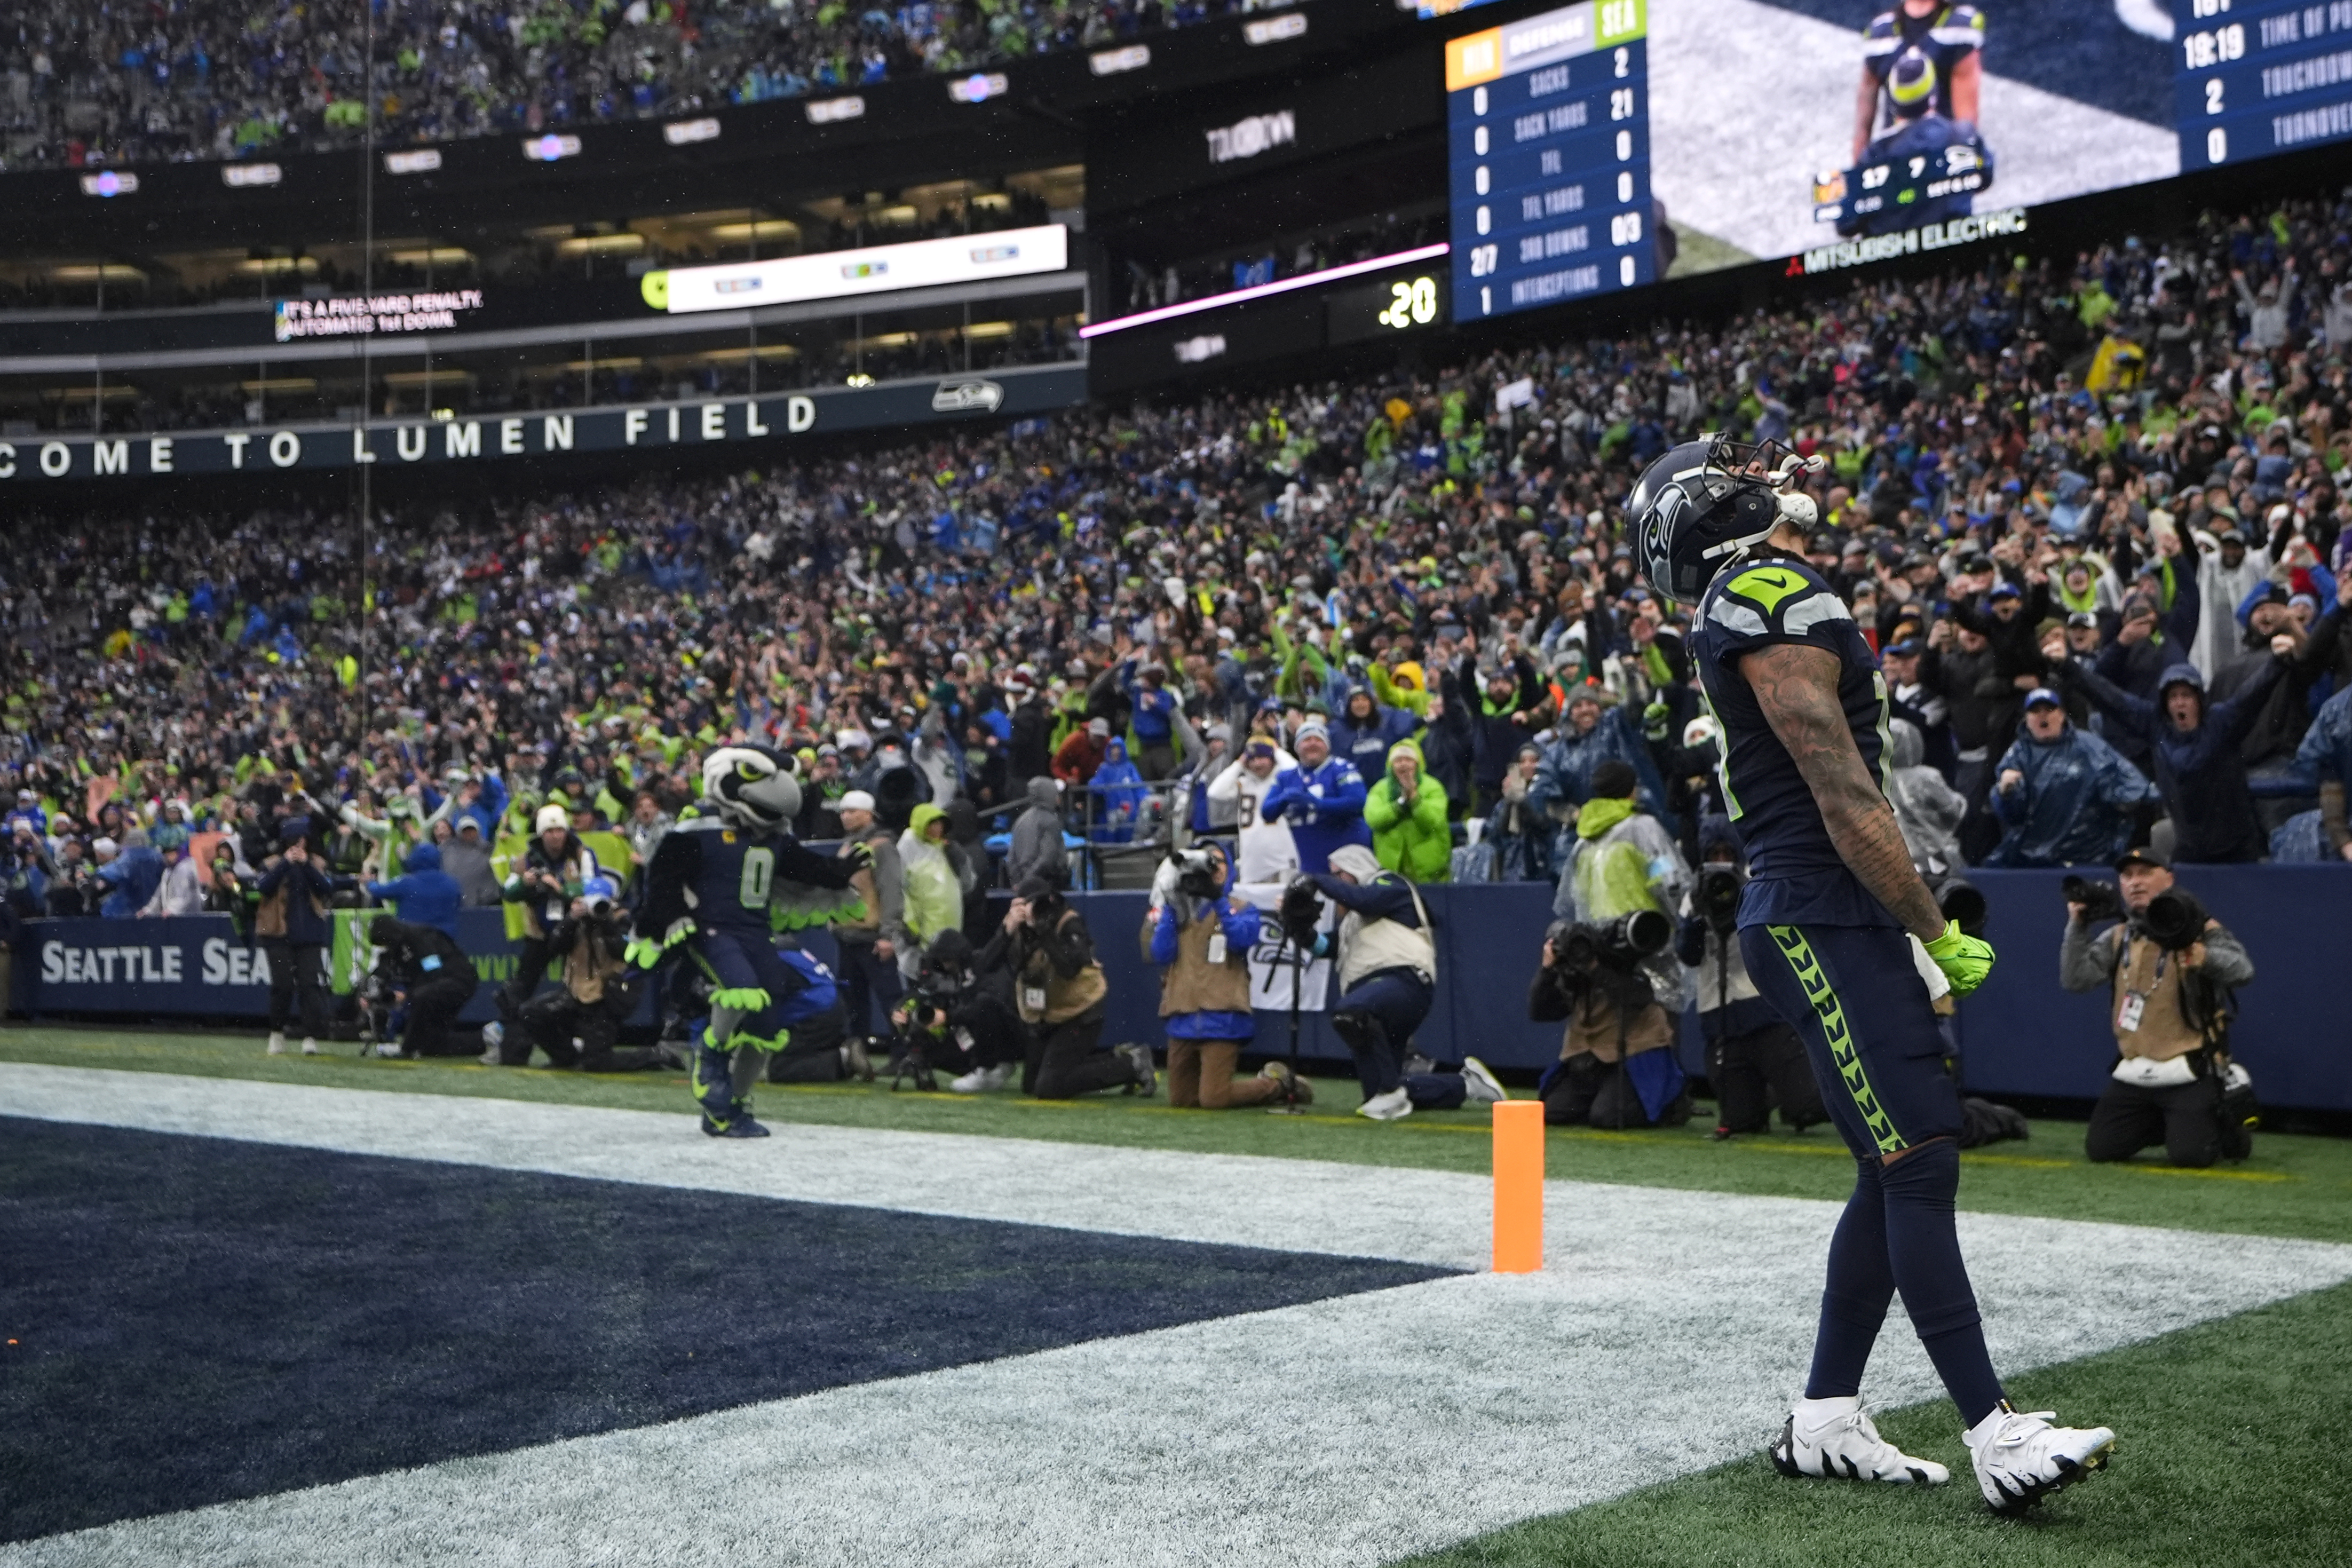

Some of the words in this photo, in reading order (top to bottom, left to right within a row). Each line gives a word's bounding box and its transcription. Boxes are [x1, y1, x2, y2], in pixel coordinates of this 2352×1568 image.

[1602, 0, 1637, 37] SEA
[1614, 47, 1629, 78] 2
[1611, 88, 1634, 121] 21
[2206, 78, 2224, 115] 2
[2207, 127, 2228, 164] 0
[1804, 228, 1919, 275] MITSUBISHI
[1921, 207, 2028, 251] ELECTRIC
[1480, 286, 1492, 315] 1
[1620, 255, 1636, 287] 0
[225, 431, 302, 470] TO
[354, 414, 574, 463] LUMEN
[625, 395, 816, 446] FIELD
[739, 846, 775, 909] 0
[42, 940, 183, 984] SEATTLE
